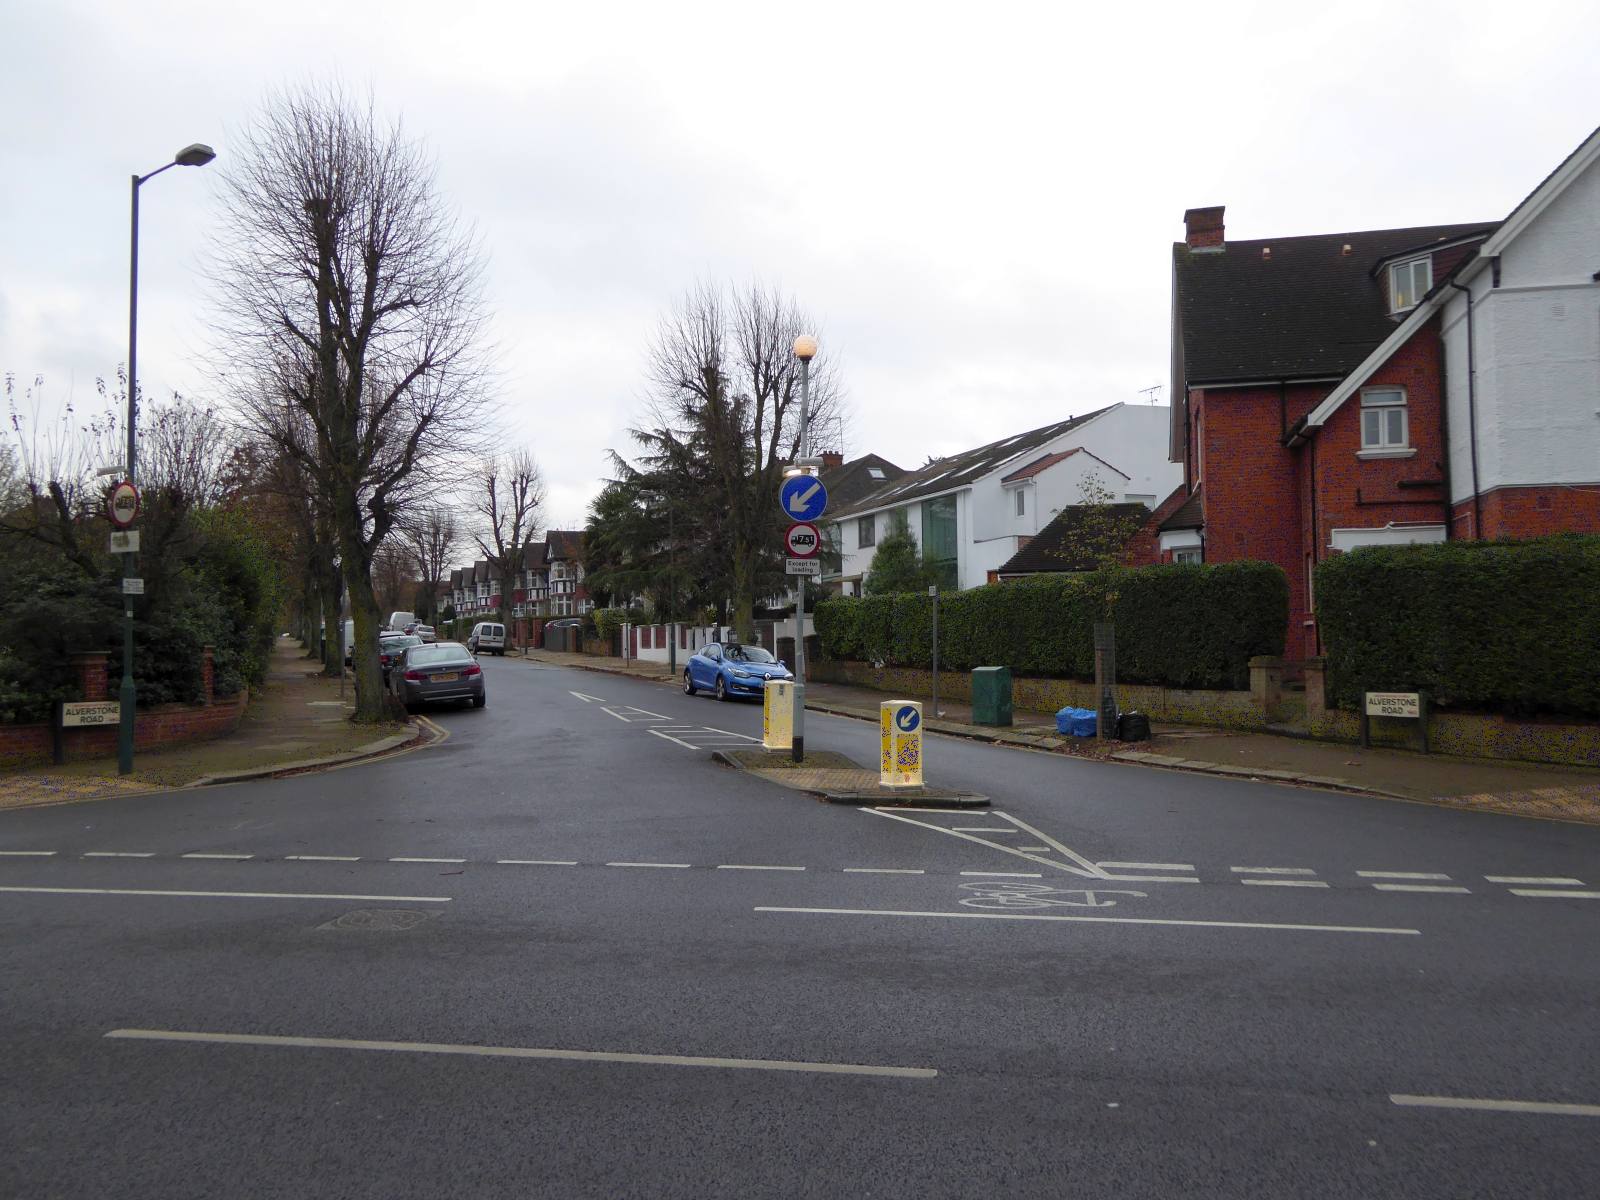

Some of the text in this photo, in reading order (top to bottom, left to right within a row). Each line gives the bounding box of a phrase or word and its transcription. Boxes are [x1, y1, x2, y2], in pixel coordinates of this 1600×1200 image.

[1368, 698, 1417, 706] ALVERSTONE
[65, 706, 119, 716] ALVERSTONE
[1381, 706, 1404, 714] ROAD
[80, 715, 104, 724] ROAD
